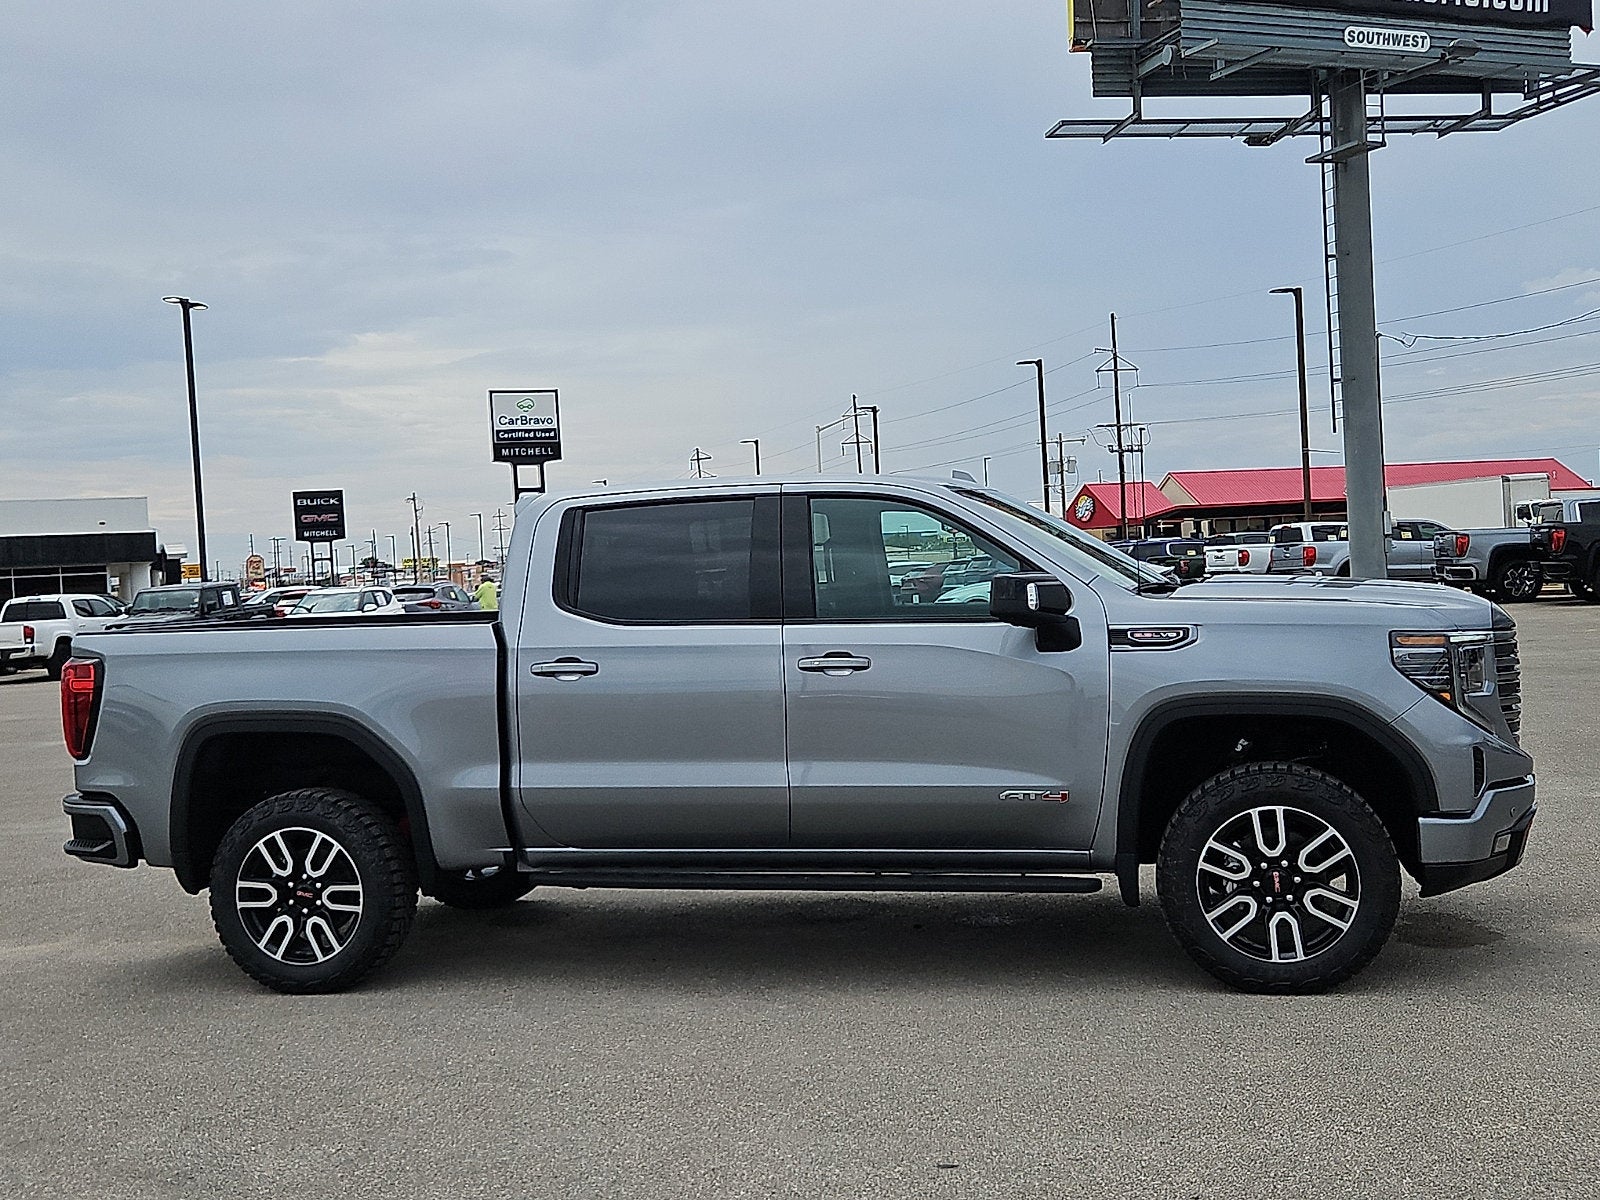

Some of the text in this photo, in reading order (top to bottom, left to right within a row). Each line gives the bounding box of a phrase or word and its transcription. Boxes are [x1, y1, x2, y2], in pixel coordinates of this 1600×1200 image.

[1347, 29, 1428, 49] SOUTHWEST
[498, 415, 554, 426] CarBravo
[498, 430, 555, 439] Certified Used
[501, 447, 554, 456] MITCHELL
[296, 497, 340, 506] BUICK
[300, 513, 339, 523] GMC
[303, 529, 339, 537] MITCHELL
[999, 790, 1069, 804] AT4
[1272, 871, 1281, 893] GMC
[296, 890, 314, 899] GMC
